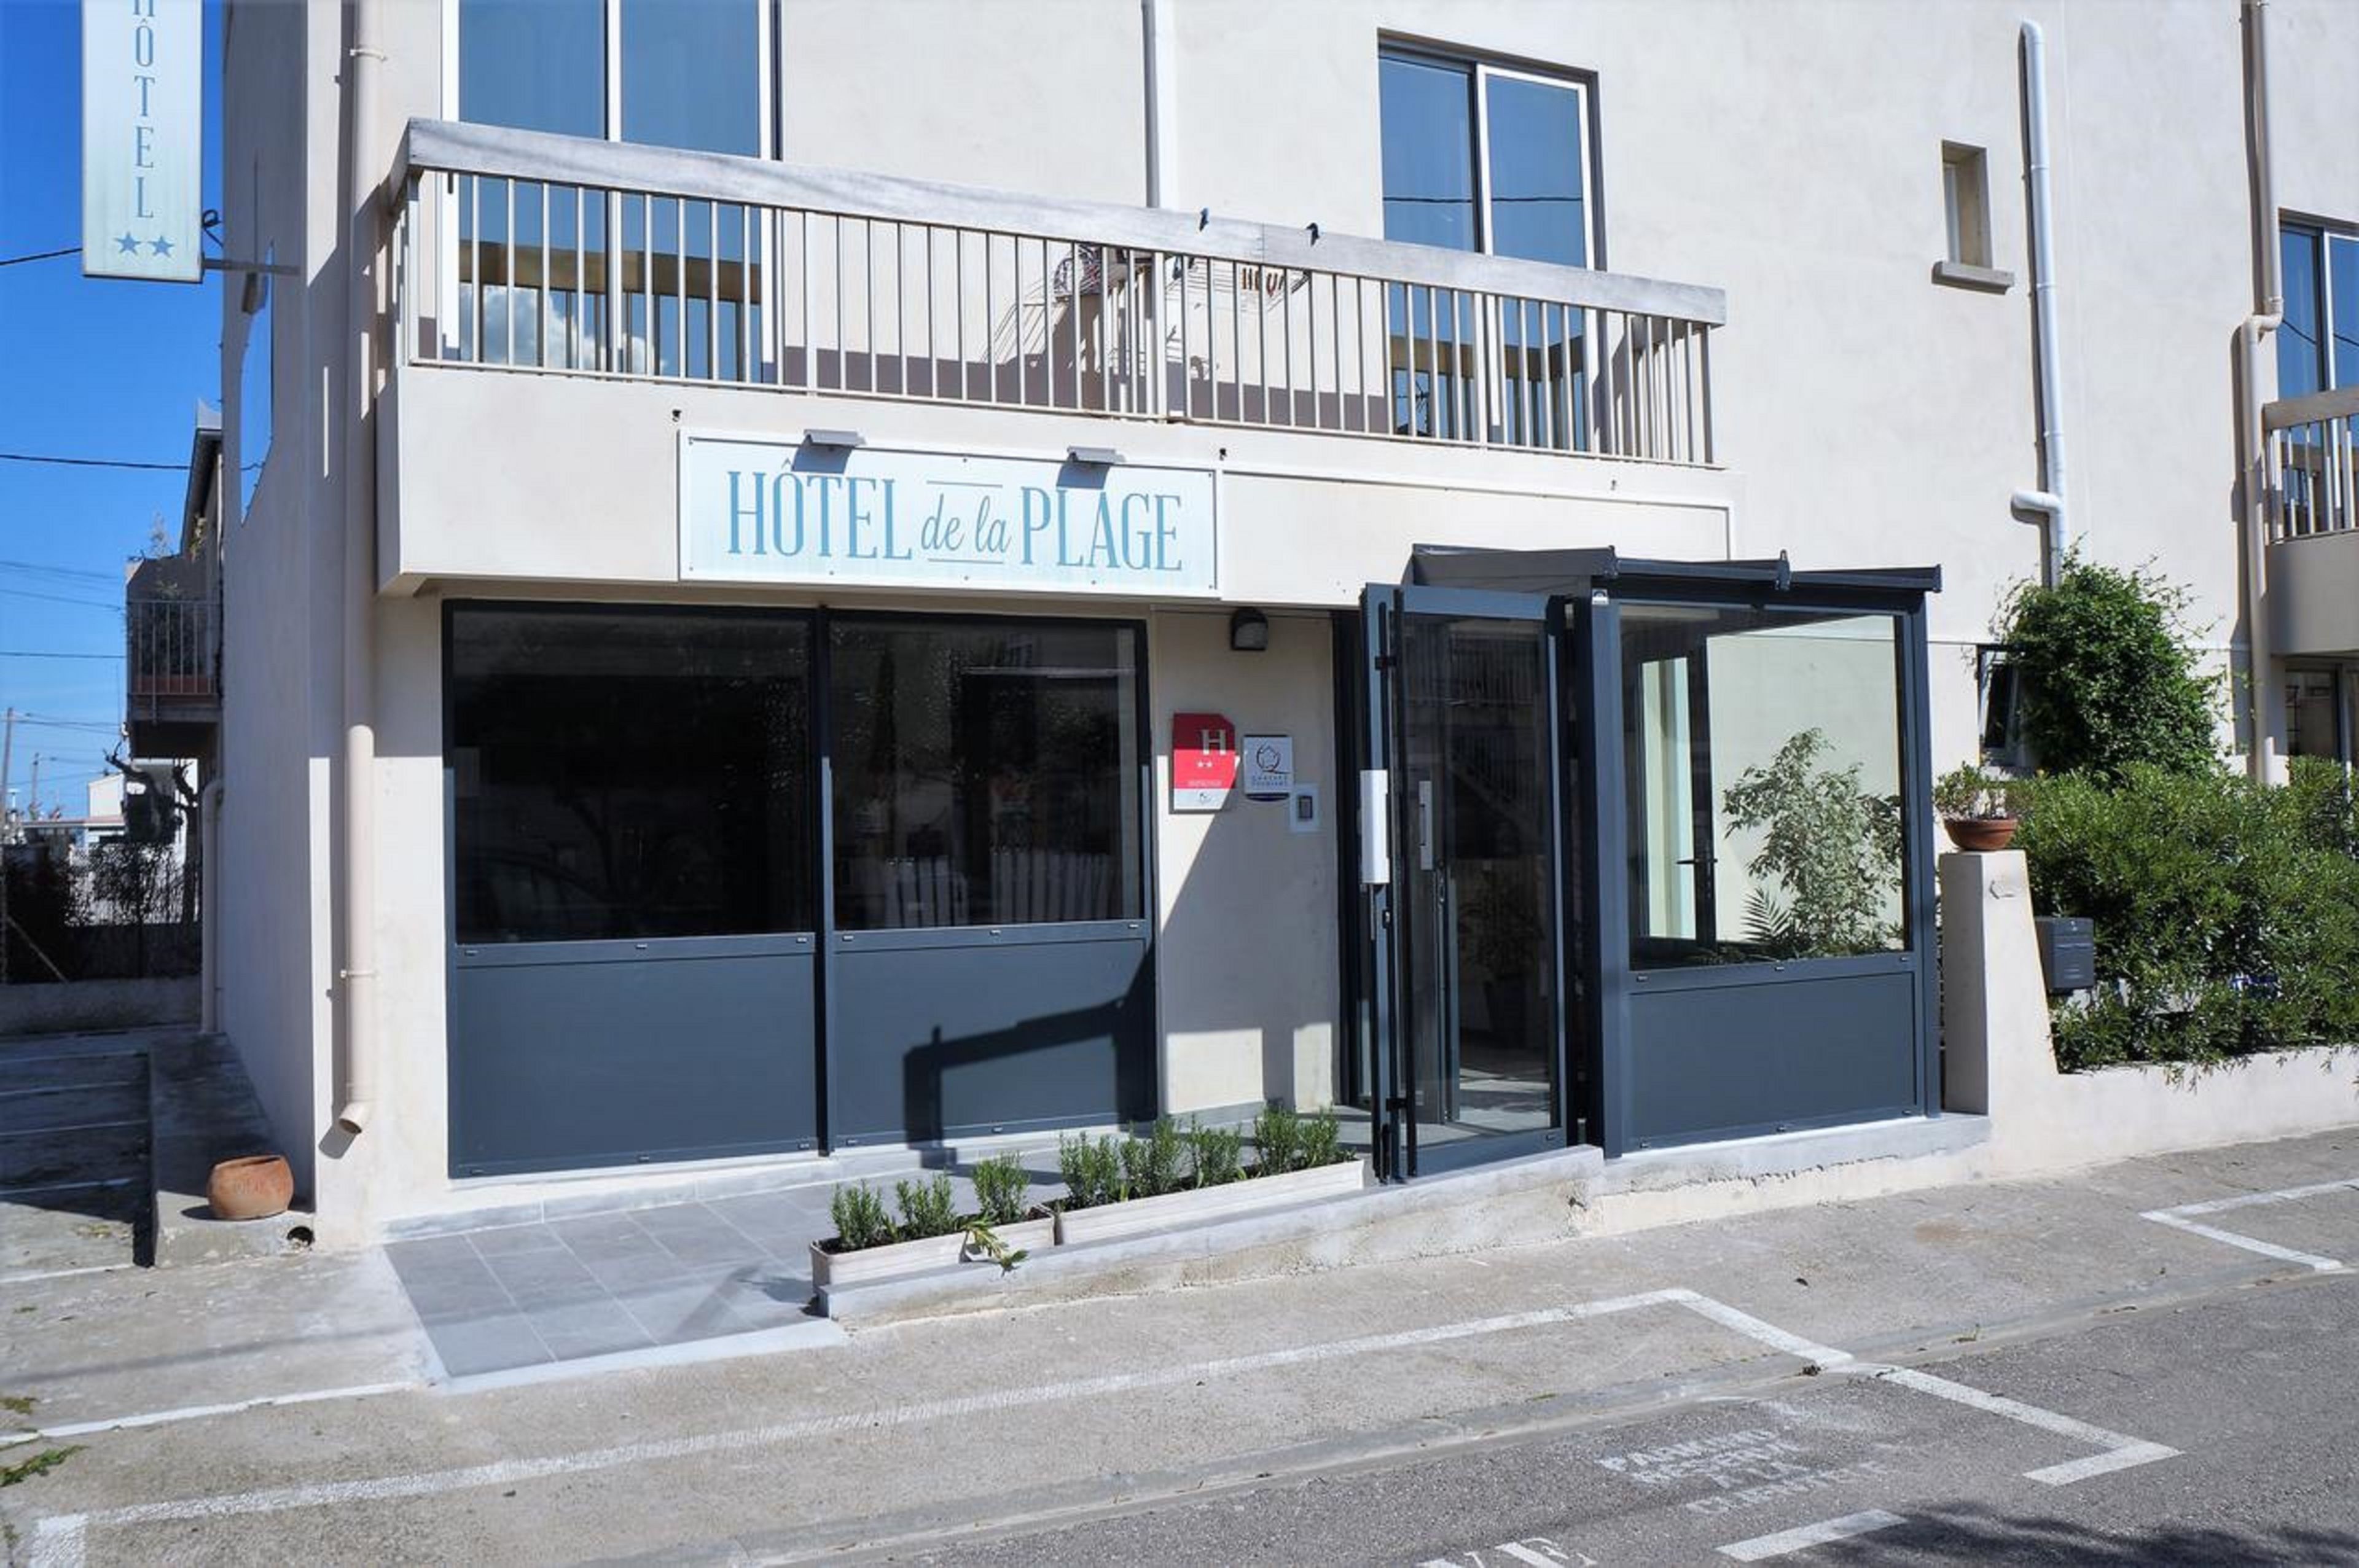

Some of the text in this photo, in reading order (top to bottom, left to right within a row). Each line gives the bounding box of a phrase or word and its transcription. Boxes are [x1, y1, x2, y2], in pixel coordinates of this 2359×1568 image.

[727, 458, 1183, 571] HÔTEL de la PLAGE
[1200, 729, 1227, 755] H
